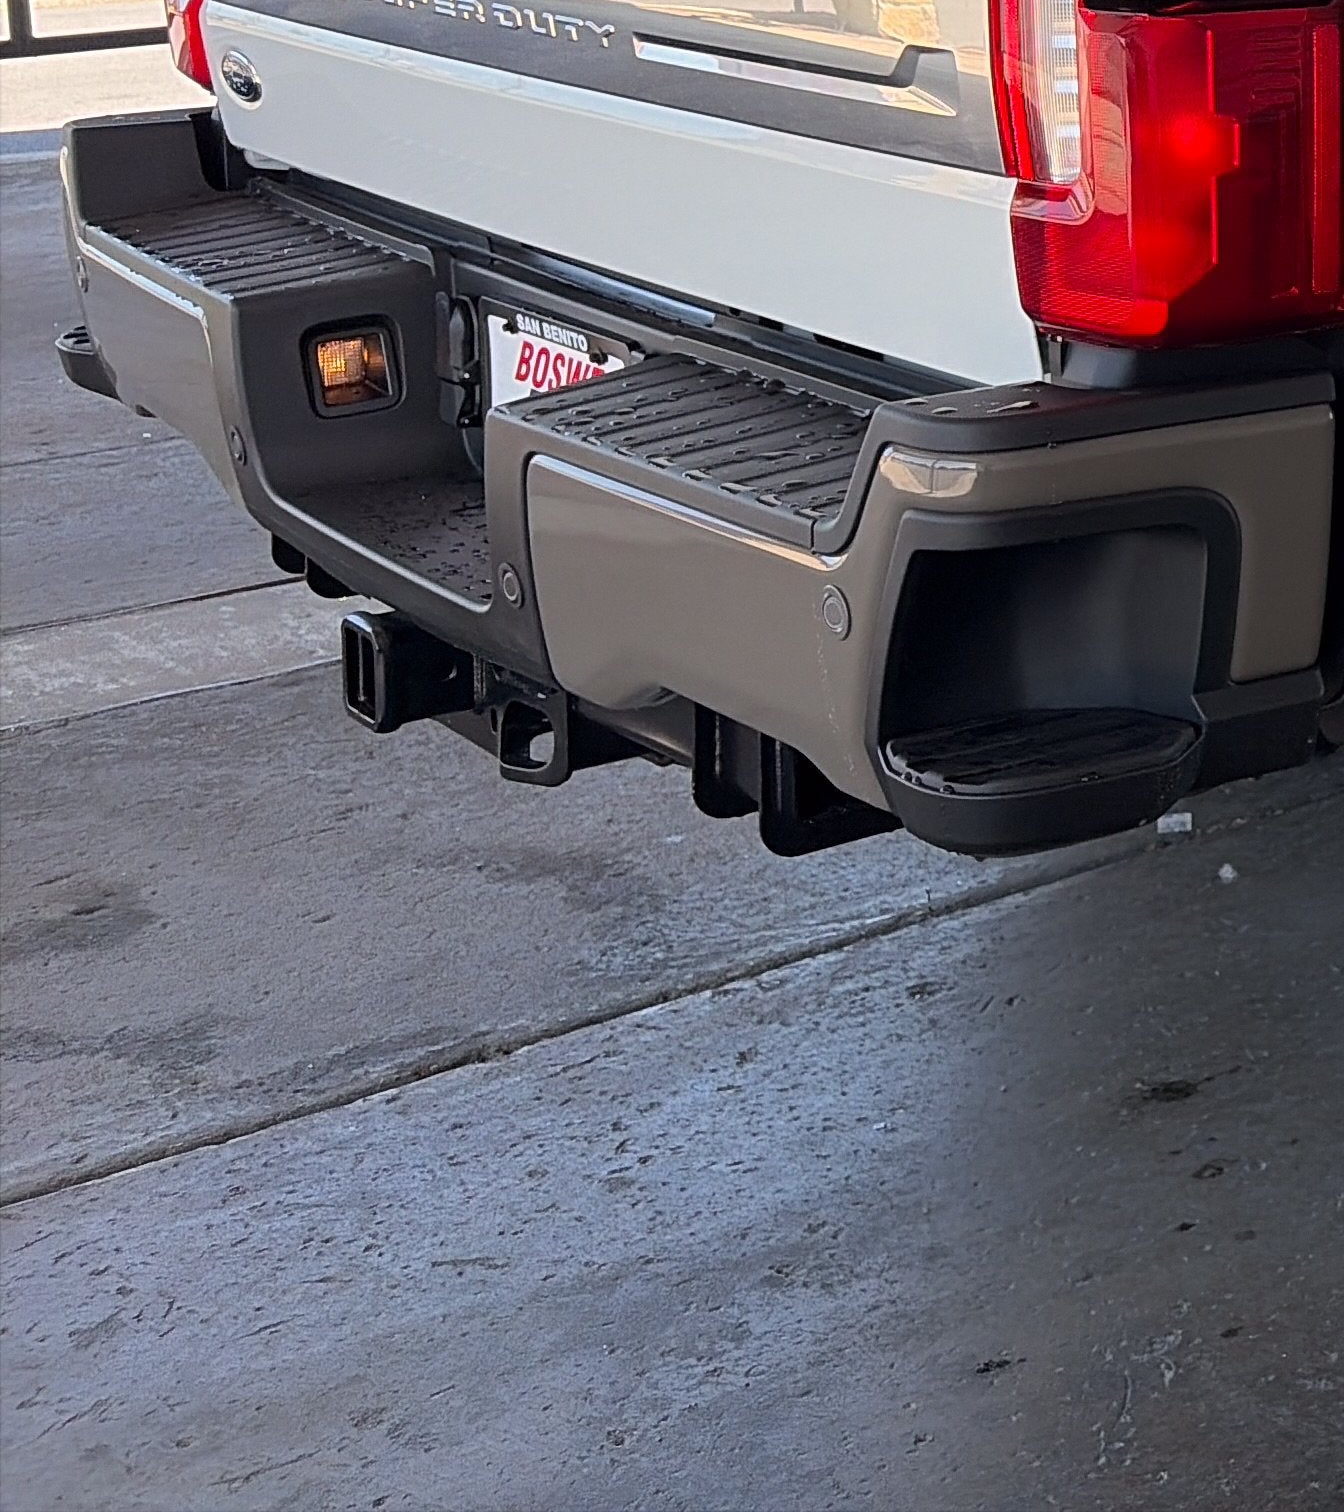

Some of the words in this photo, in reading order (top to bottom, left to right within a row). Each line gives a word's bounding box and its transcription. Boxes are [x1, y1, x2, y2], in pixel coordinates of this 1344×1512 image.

[491, 2, 616, 49] DUTY
[515, 313, 541, 335] SAN
[542, 318, 589, 352] BENITO
